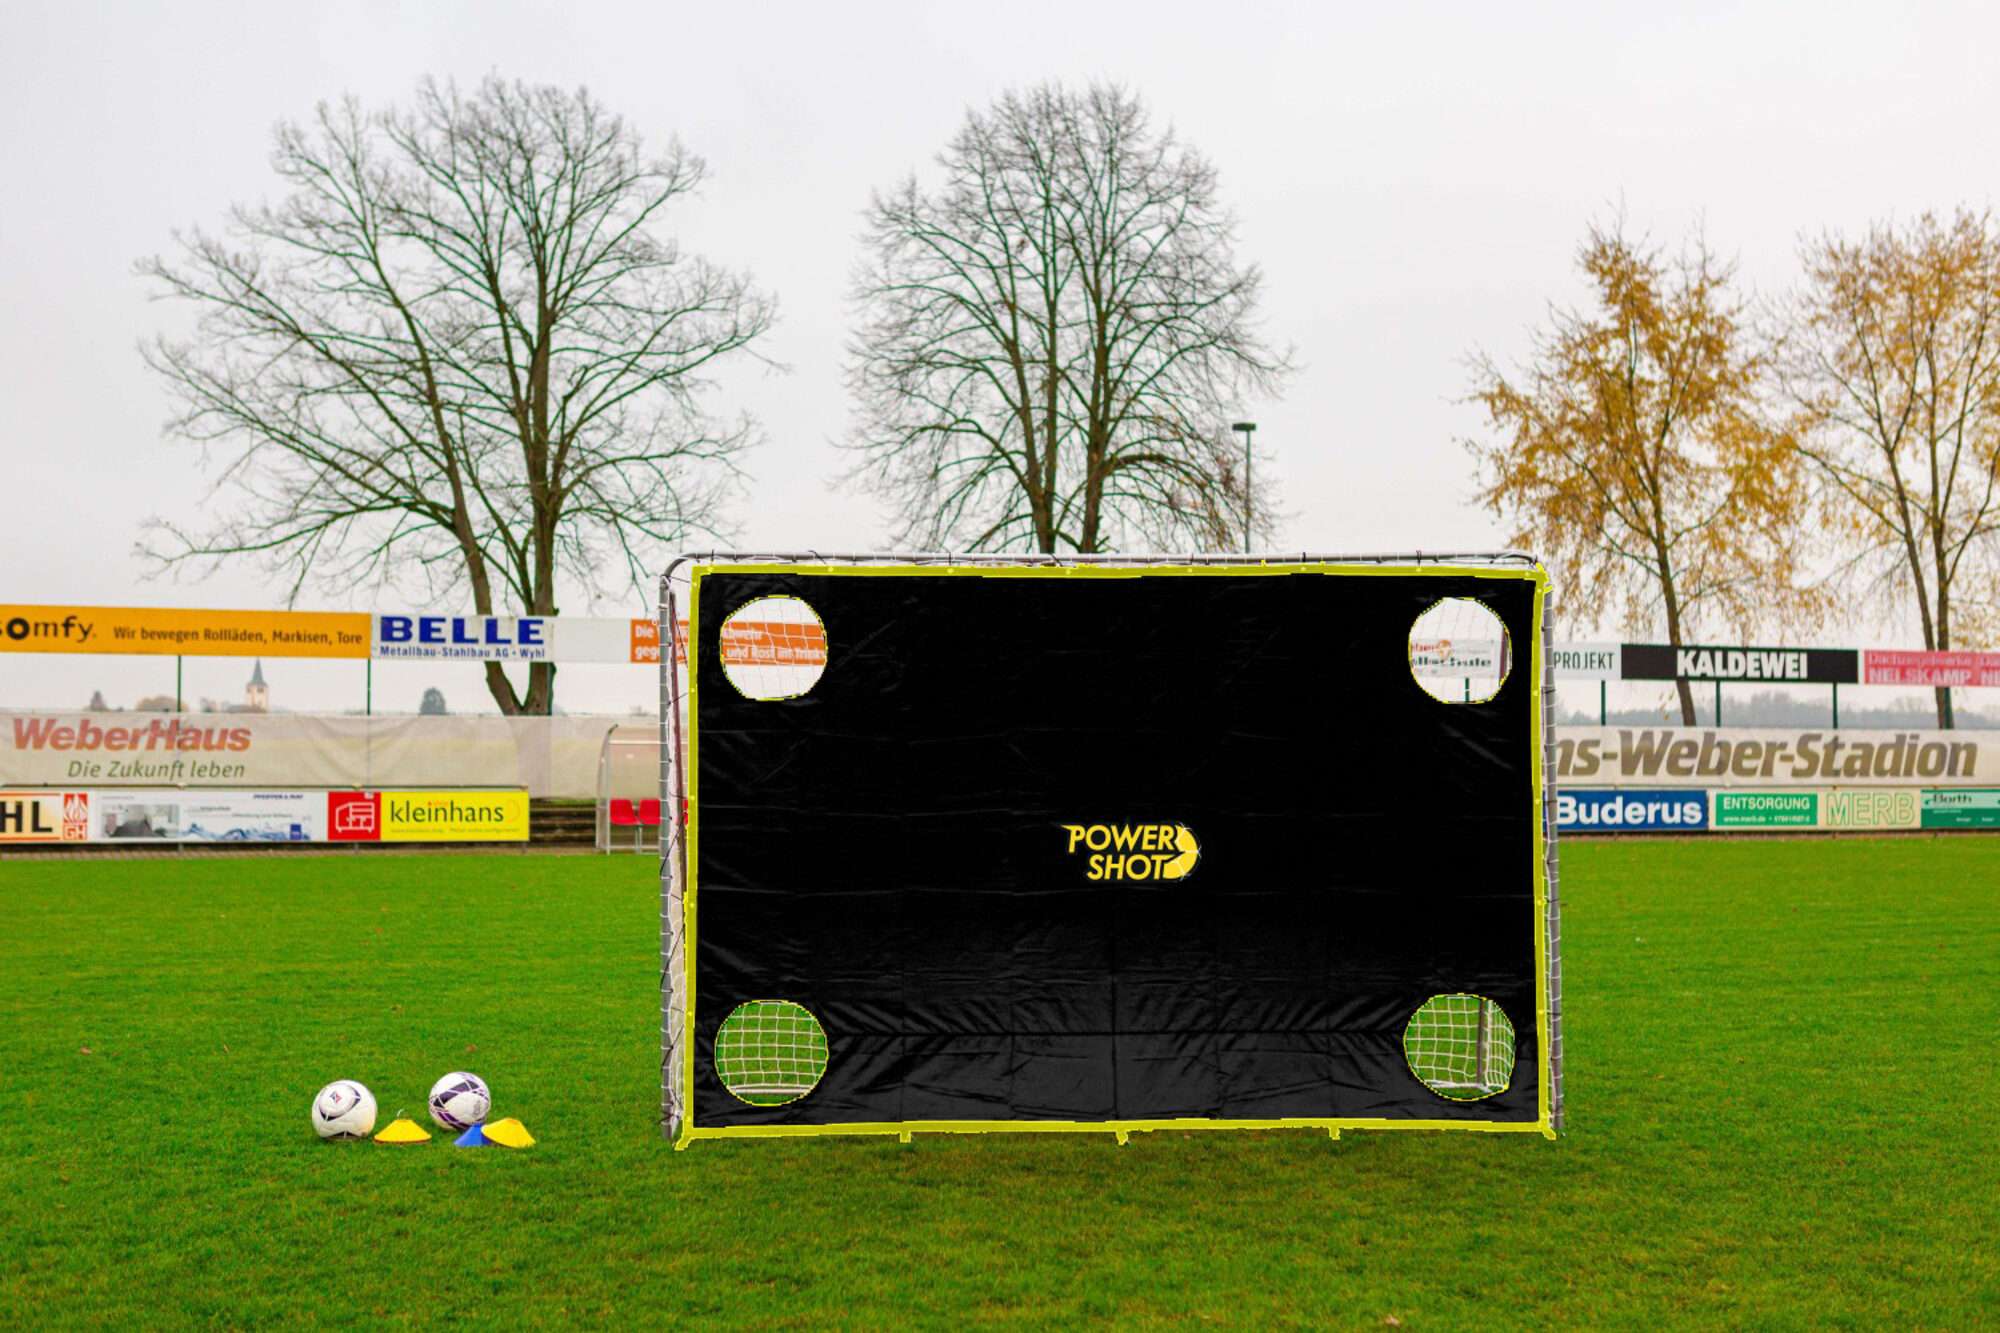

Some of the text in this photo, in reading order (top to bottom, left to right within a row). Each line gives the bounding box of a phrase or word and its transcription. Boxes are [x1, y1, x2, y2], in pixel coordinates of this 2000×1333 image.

[113, 626, 363, 646] Wir bewegen Rollläden, Markisen, Tore
[380, 616, 544, 645] BELLE
[634, 625, 654, 638] Die
[380, 646, 545, 660] Metallbau-Stahlbau AG Wyhl
[1553, 651, 1615, 669] PROJEKT
[1676, 649, 1808, 680] KALDEWEI
[13, 718, 252, 752] WeberHaus
[68, 760, 245, 781] Die Zukunft leben
[390, 800, 504, 823] kleinhans
[1557, 795, 1702, 825] Buderus
[1723, 796, 1810, 810] ENTSORGUNG
[1825, 793, 1915, 825] MERB
[1060, 824, 1175, 853] POWER
[1087, 854, 1175, 881] SHOT
